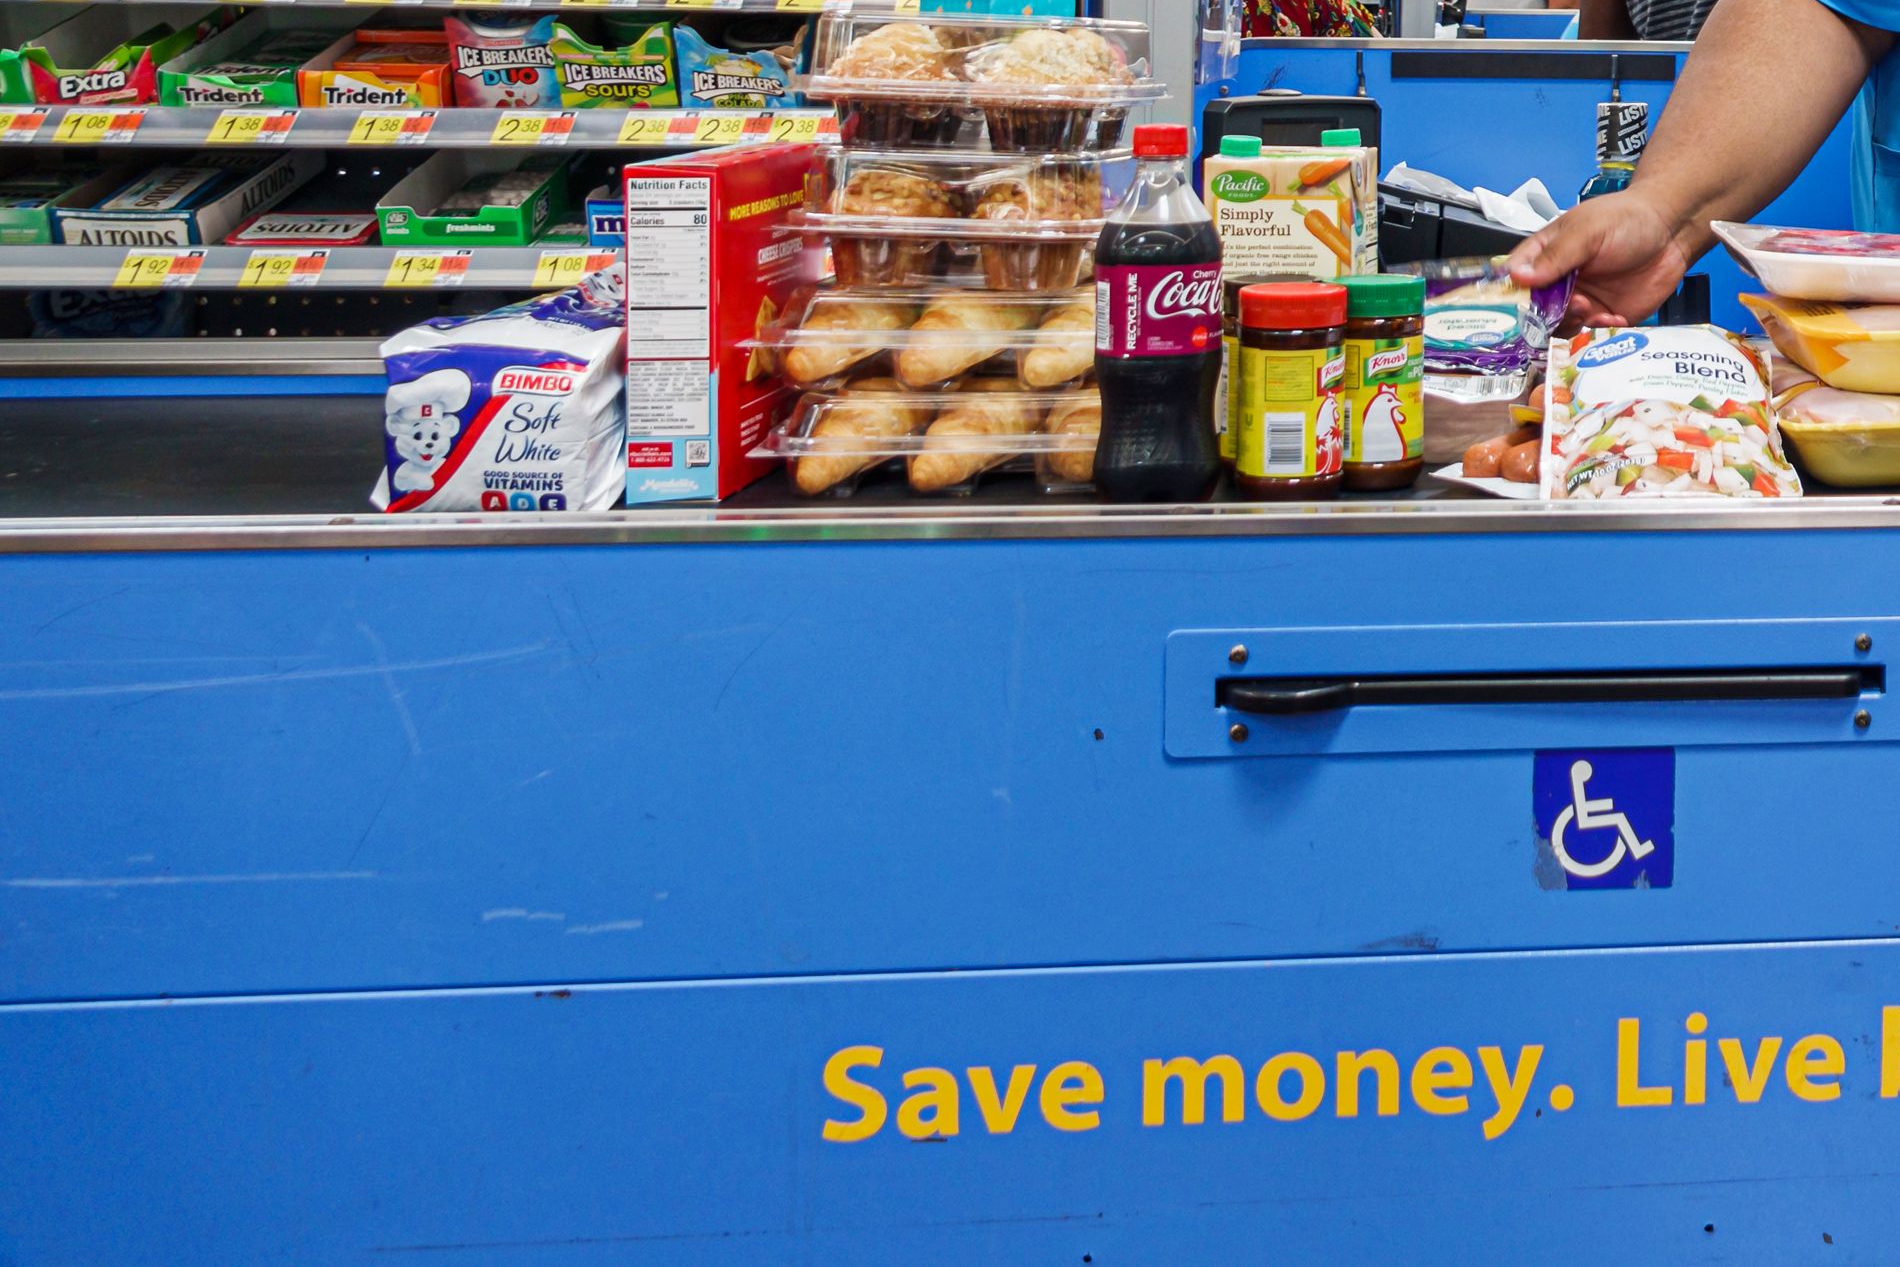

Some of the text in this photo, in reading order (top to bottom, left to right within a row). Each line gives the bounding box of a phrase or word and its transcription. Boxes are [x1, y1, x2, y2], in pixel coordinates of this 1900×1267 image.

[458, 46, 554, 68] ICE BREAKERS
[483, 68, 539, 86] DUO
[564, 63, 666, 85] ICE BREAKERS
[60, 70, 126, 98] Extra
[586, 84, 650, 98] sours
[324, 87, 406, 104] Trident
[240, 160, 296, 218] ALTOIDS
[630, 180, 708, 190] Nutrition Facts
[1216, 173, 1265, 192] Pacific
[729, 189, 805, 222] MORE REASONS TO LOVE
[630, 214, 708, 226] Calories 80
[1220, 208, 1274, 224] Simply
[446, 224, 496, 233] freshmints
[1220, 224, 1292, 237] Flavorful
[1193, 270, 1217, 280] Cherry
[1146, 270, 1222, 320] Coca-C
[1126, 273, 1138, 350] RECYCLE ME
[1584, 336, 1637, 360] Great
[1371, 350, 1406, 369] Knorr
[1641, 350, 1744, 374] Seasoning
[500, 373, 573, 392] BIMBO
[1674, 362, 1746, 384] Blend
[504, 402, 562, 434] Soft
[494, 434, 562, 464] White
[483, 470, 564, 480] GOOD SOURCE OF
[484, 478, 564, 492] VITAMINS
[821, 1045, 1104, 1143] Save
[1142, 1042, 1574, 1142] money.
[1615, 1013, 1844, 1108] Live
